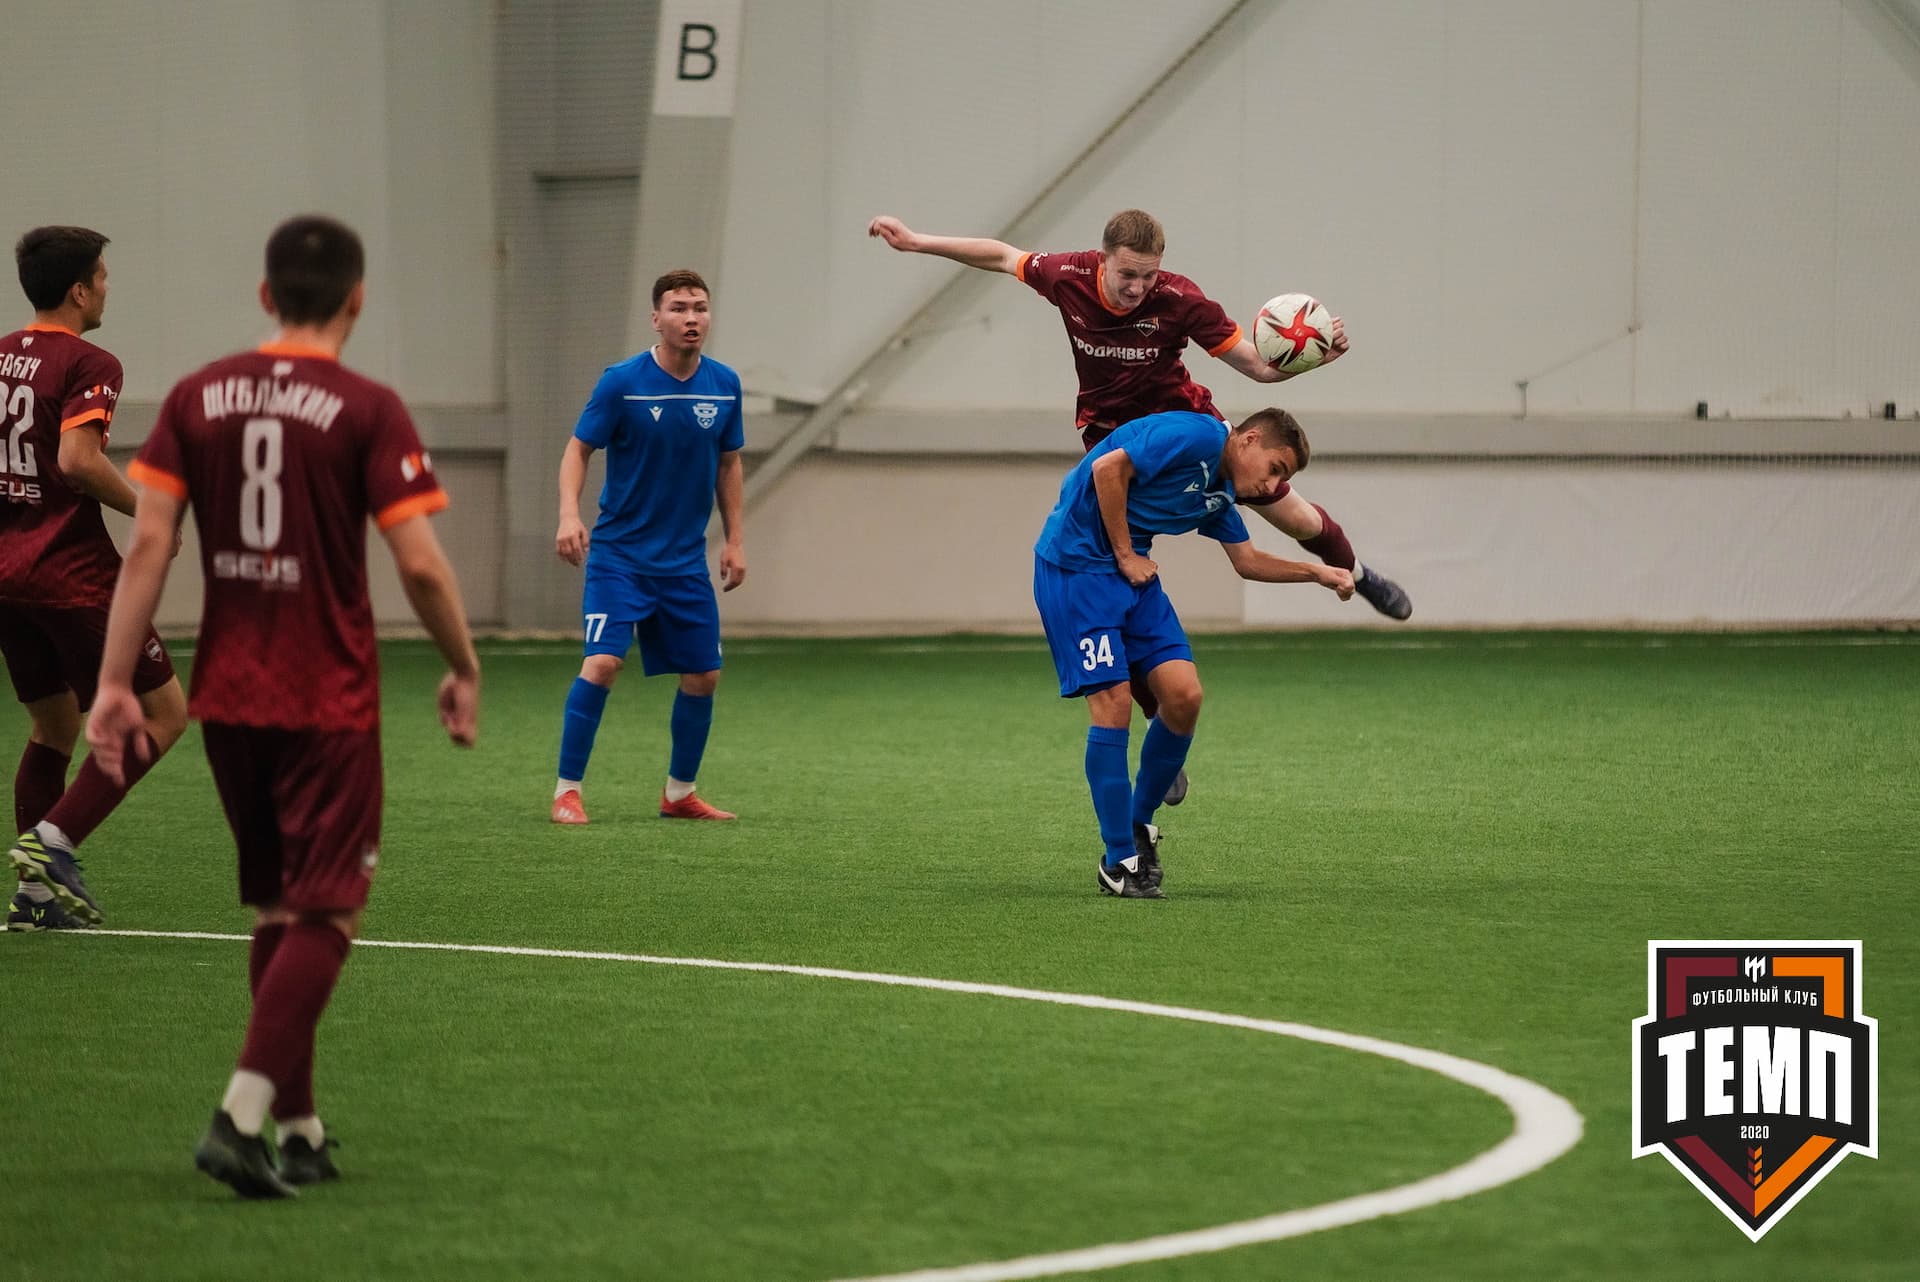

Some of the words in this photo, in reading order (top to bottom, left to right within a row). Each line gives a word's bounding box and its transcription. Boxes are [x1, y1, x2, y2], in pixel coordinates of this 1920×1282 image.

[678, 23, 718, 80] B
[240, 418, 283, 551] 8
[585, 613, 608, 643] 77
[1080, 634, 1115, 671] 34
